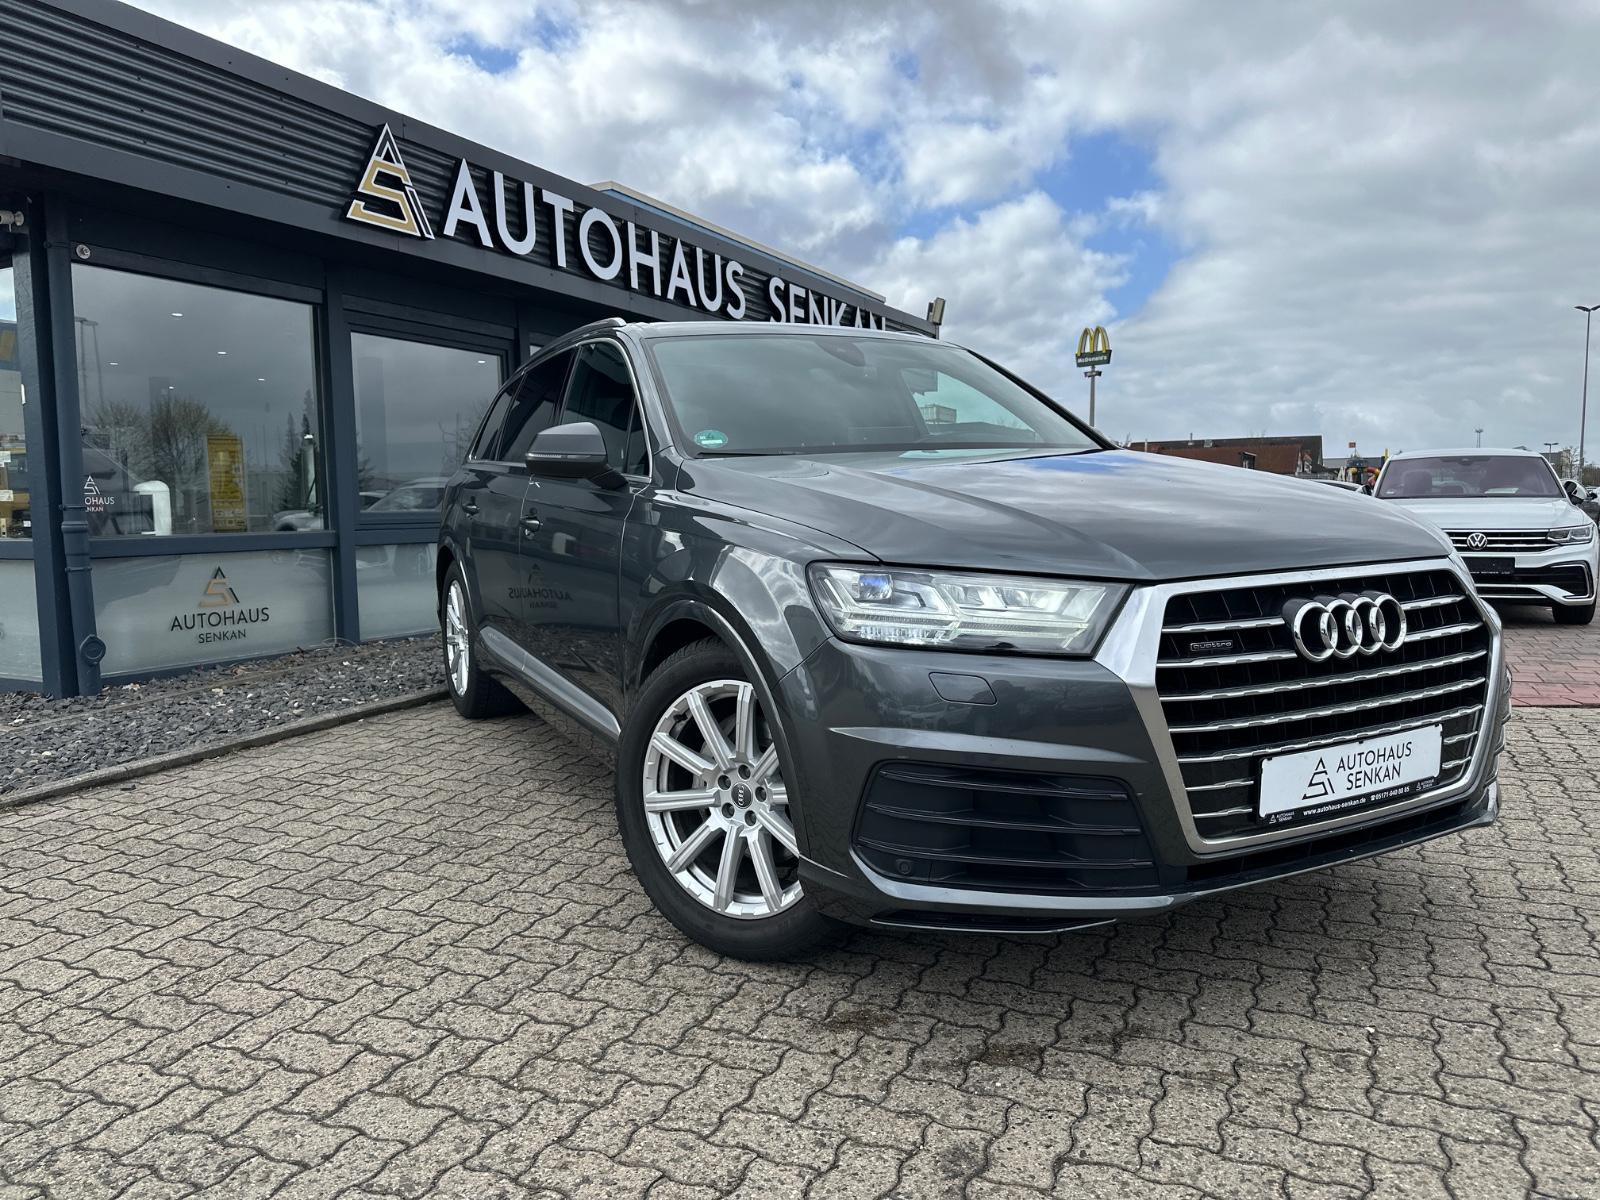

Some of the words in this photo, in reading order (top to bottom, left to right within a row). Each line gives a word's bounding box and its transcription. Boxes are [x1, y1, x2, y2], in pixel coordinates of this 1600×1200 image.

[443, 157, 746, 320] AUTOHAUS
[84, 496, 115, 505] OHAUS
[170, 607, 270, 631] AUTOHAUS
[198, 629, 246, 643] SENKAN
[1336, 741, 1413, 773] AUTOHAUS
[1346, 762, 1402, 791] SENKAN
[1303, 796, 1366, 816] www.autohaus-senkan.de
